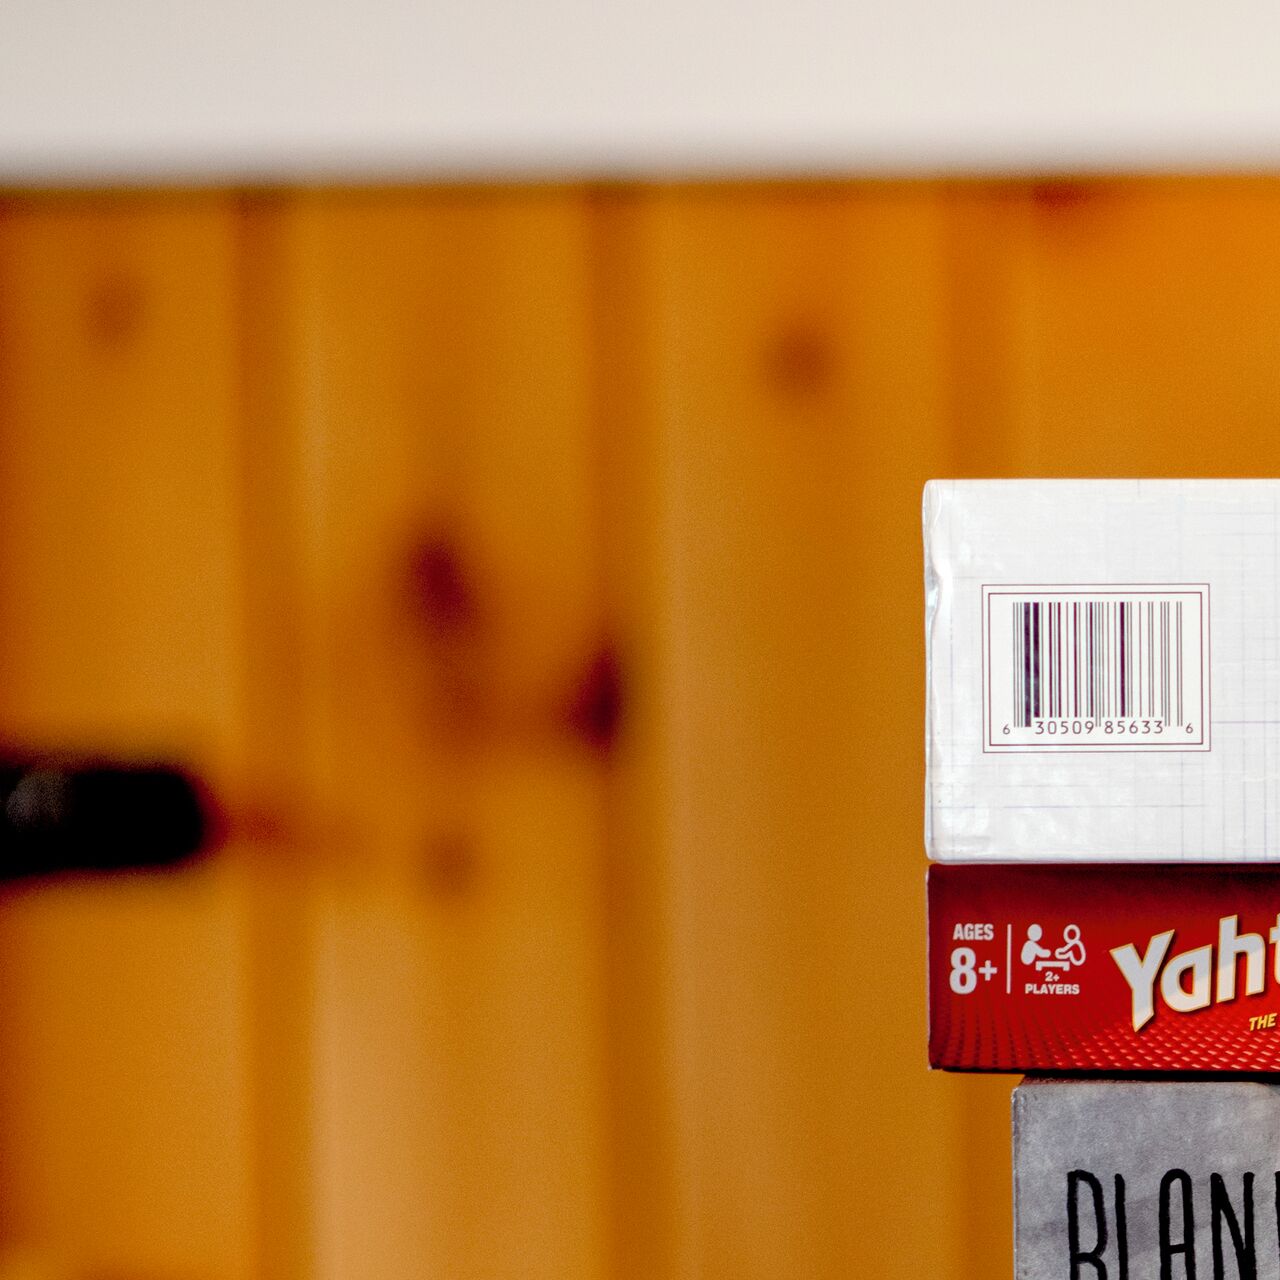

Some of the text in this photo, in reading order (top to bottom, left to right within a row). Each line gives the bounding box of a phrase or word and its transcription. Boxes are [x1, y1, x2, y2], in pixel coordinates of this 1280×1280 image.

[1002, 720, 1193, 736] 6 30509 85633 6
[953, 924, 994, 941] AGES
[949, 948, 997, 994] 8+
[1044, 972, 1060, 983] 2+
[1025, 983, 1080, 995] PLAYERS
[1248, 1013, 1277, 1031] THE
